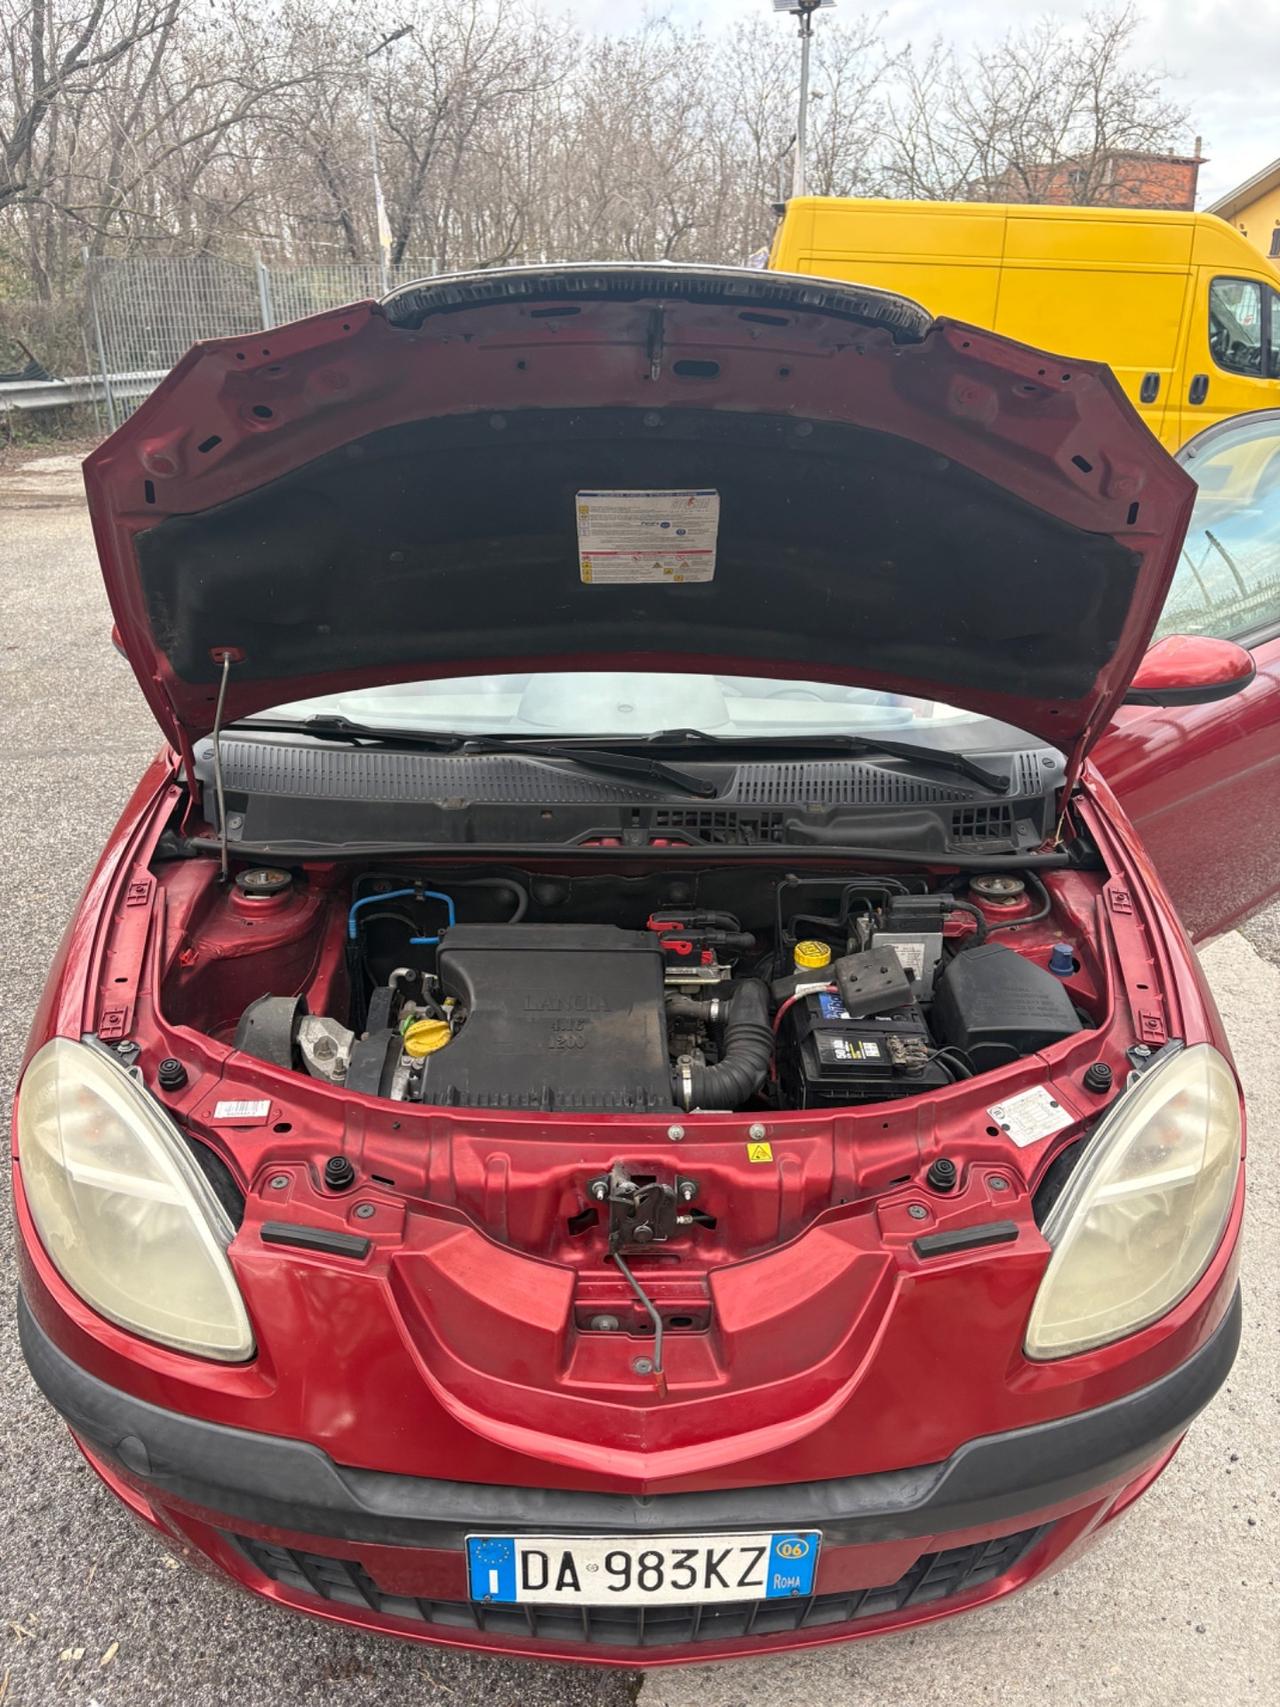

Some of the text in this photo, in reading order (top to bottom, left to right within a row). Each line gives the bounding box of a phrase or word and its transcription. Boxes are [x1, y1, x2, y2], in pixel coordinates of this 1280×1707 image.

[523, 993, 613, 1013] LANCIA
[782, 1543, 802, 1557] 06
[488, 1546, 767, 1594] I DA 983KZ
